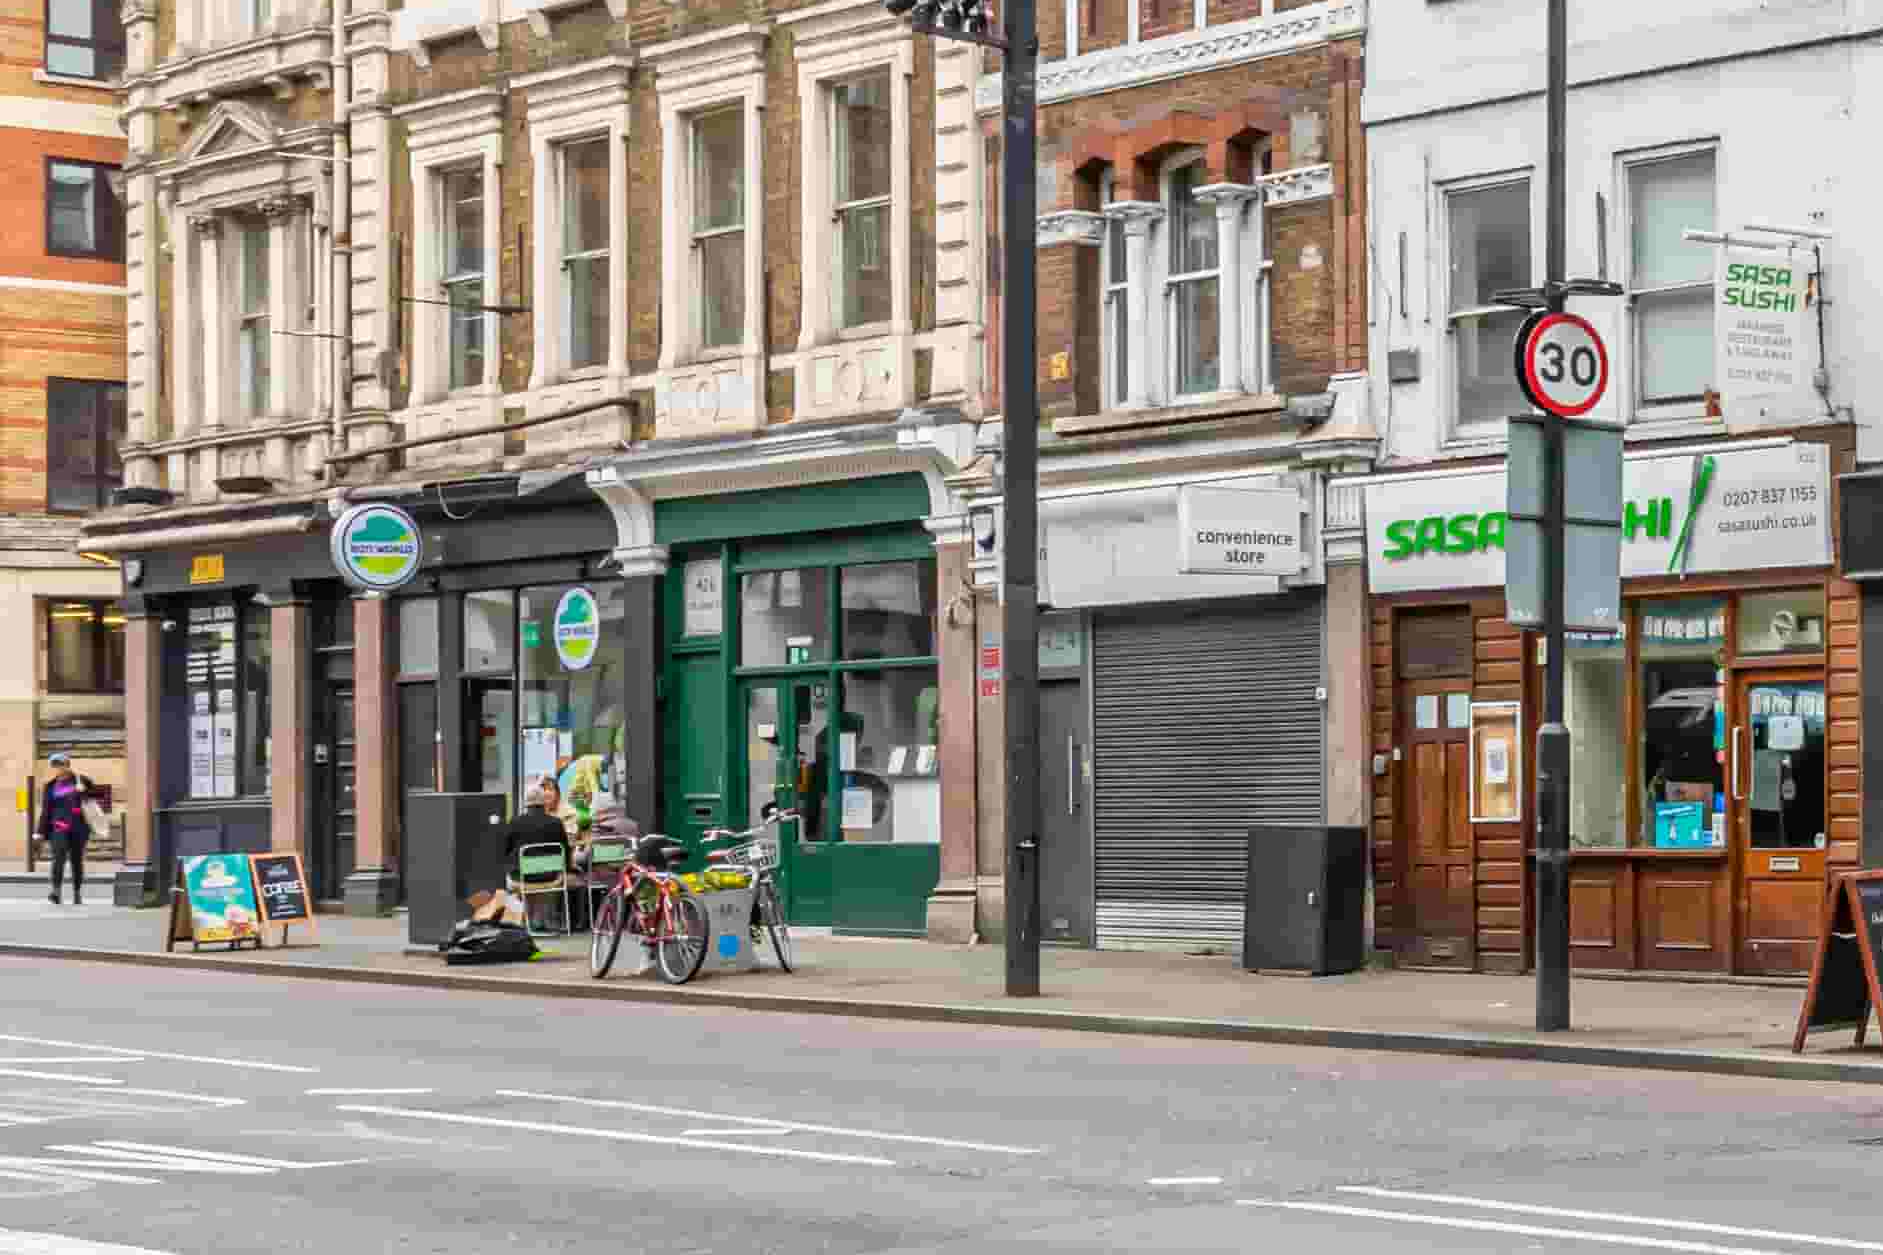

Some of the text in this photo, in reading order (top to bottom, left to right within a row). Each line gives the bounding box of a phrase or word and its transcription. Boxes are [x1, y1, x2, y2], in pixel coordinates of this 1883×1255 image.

[1727, 263, 1792, 286] SASA
[1722, 287, 1796, 312] SUSHI
[1539, 344, 1598, 387] 30
[1197, 529, 1294, 546] convenience
[1383, 511, 1506, 561] SASA
[1224, 549, 1265, 564] store
